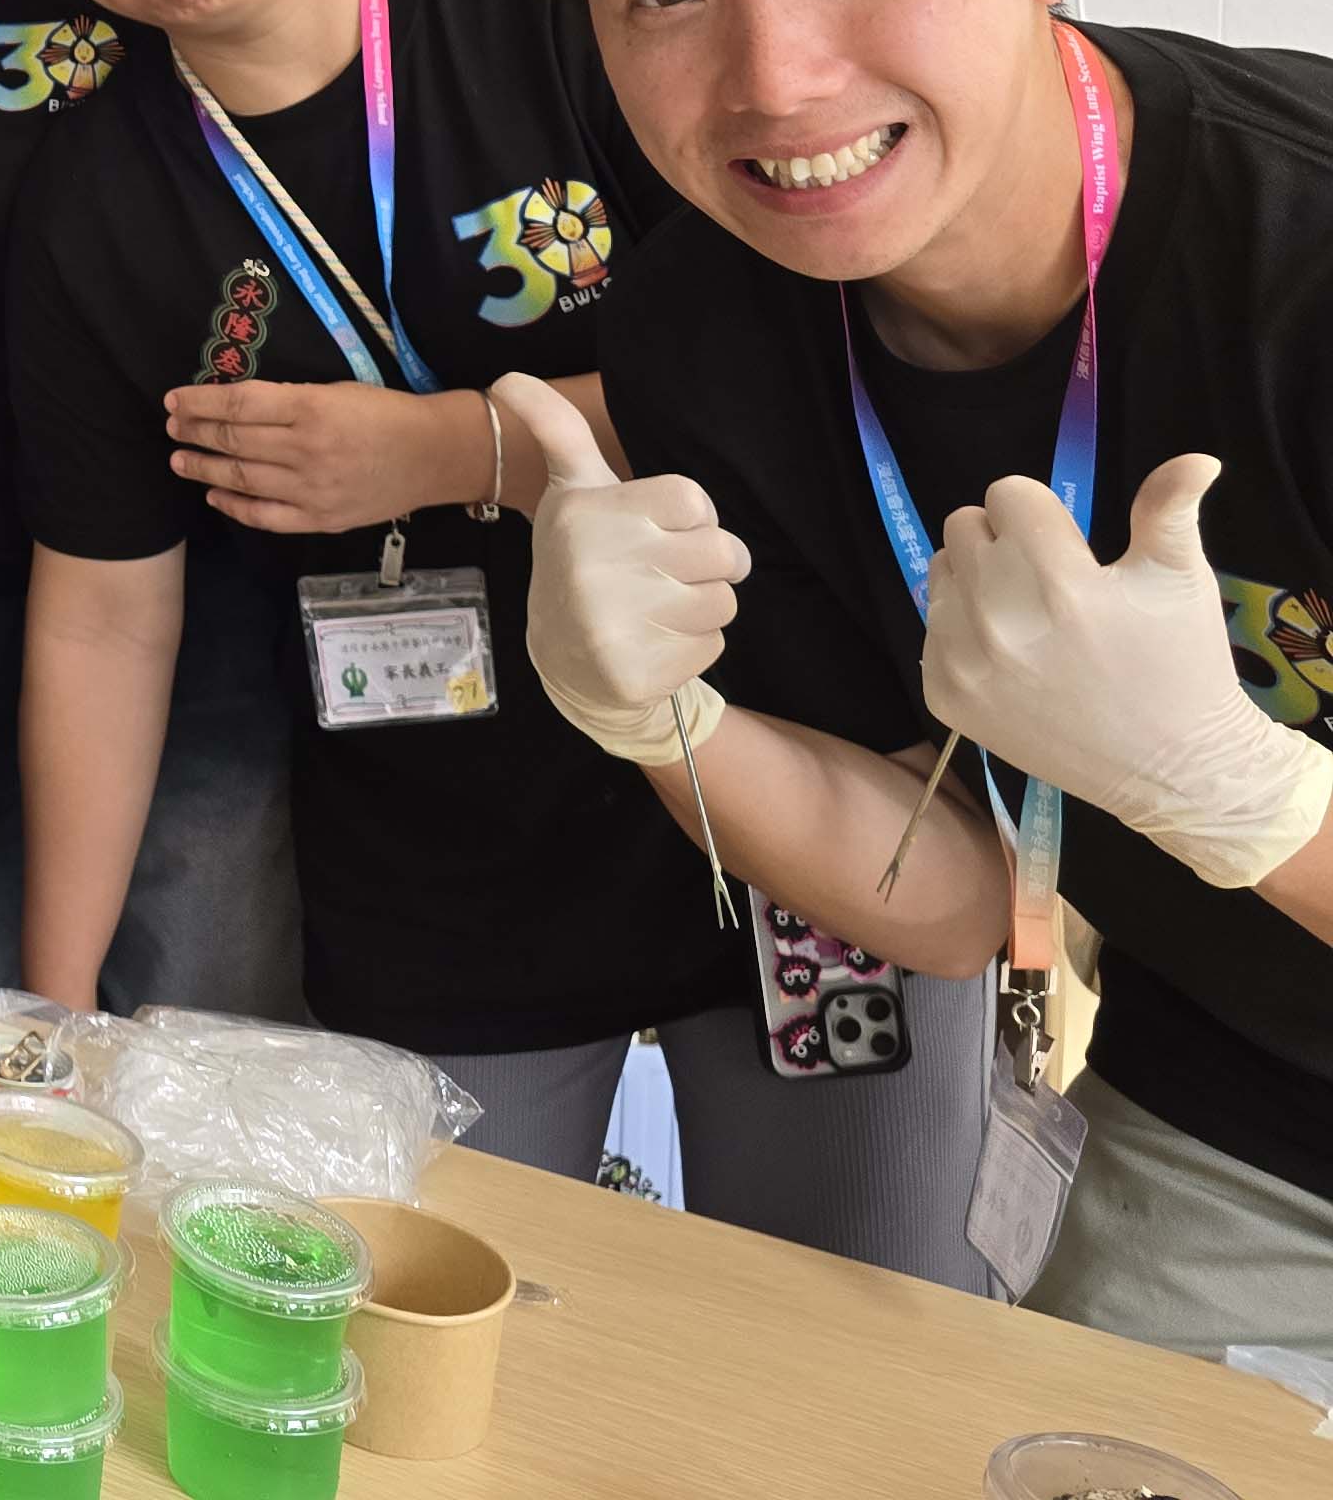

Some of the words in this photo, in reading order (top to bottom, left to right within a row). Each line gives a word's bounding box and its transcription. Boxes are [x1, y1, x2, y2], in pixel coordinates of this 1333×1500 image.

[1084, 86, 1101, 120] Lung
[1090, 123, 1105, 161] Wing
[1092, 164, 1105, 214] Baptist
[559, 277, 612, 313] BWL
[212, 280, 264, 375] 永隆叁
